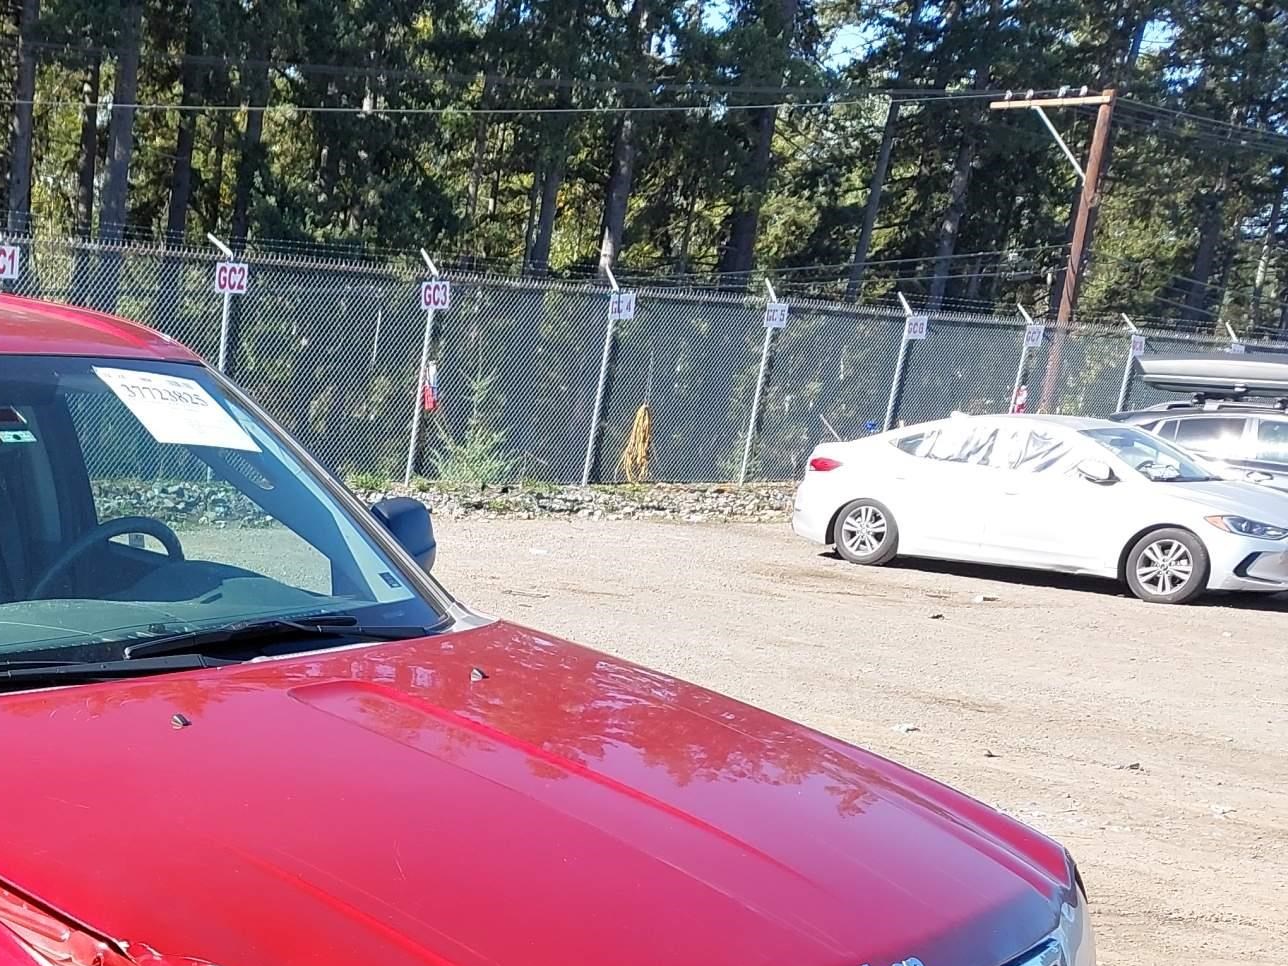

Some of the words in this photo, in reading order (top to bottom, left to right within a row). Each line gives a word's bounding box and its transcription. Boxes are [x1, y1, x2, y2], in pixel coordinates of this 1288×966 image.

[218, 265, 246, 290] GC2
[423, 283, 448, 306] GC3
[120, 383, 210, 408] 37723825
